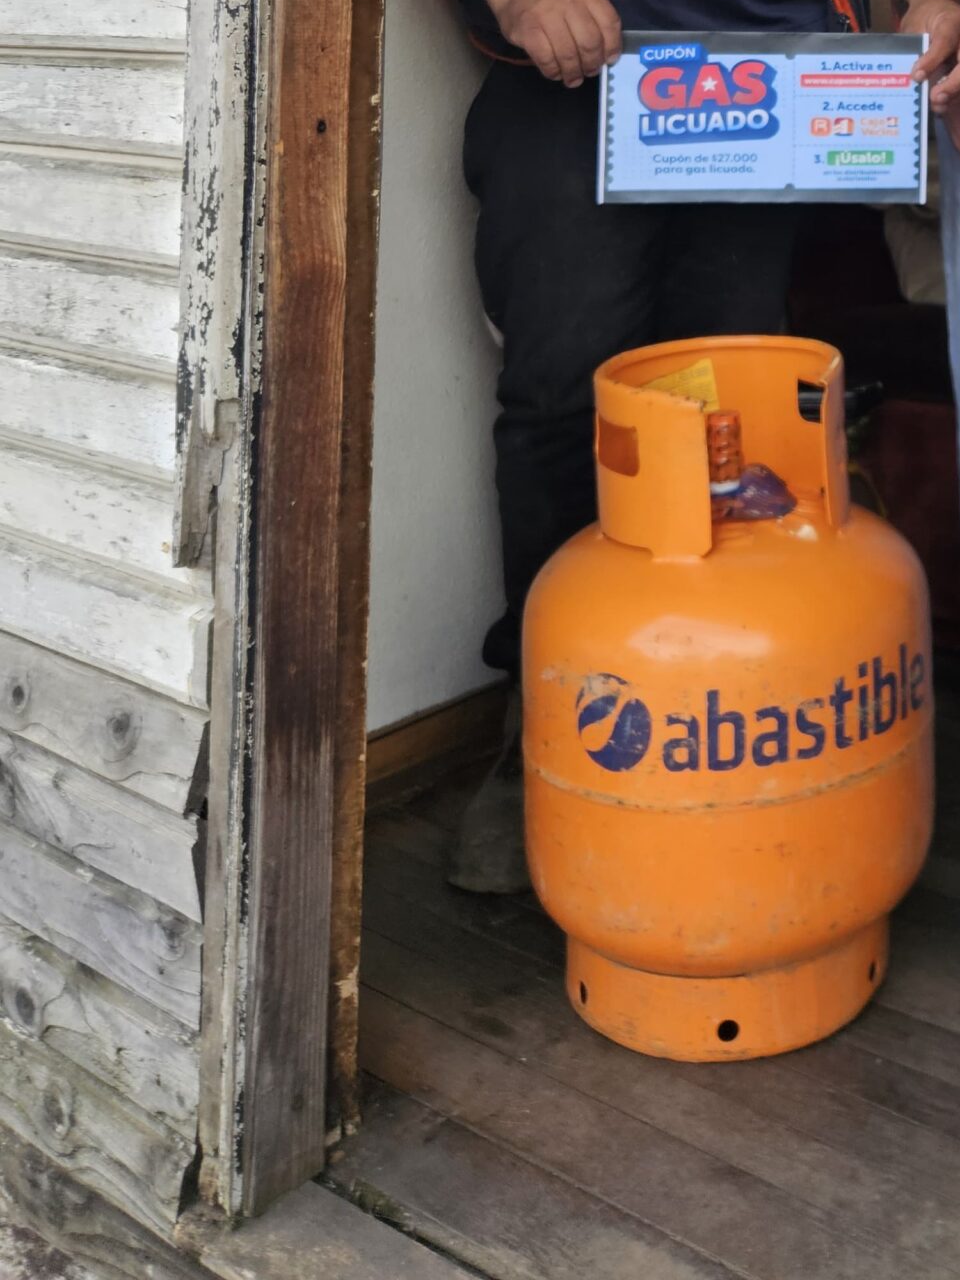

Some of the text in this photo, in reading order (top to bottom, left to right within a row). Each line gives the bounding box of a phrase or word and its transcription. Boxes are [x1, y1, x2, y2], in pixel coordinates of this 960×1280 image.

[644, 46, 696, 61] CUPÓN
[877, 63, 893, 71] en
[640, 61, 768, 110] GAS
[822, 101, 885, 111] 2. Accede
[641, 109, 770, 137] LICUADO
[652, 153, 692, 165] Cupón
[694, 153, 709, 163] de
[654, 166, 683, 176] para
[685, 166, 707, 176] gas
[662, 642, 927, 773] abastible
